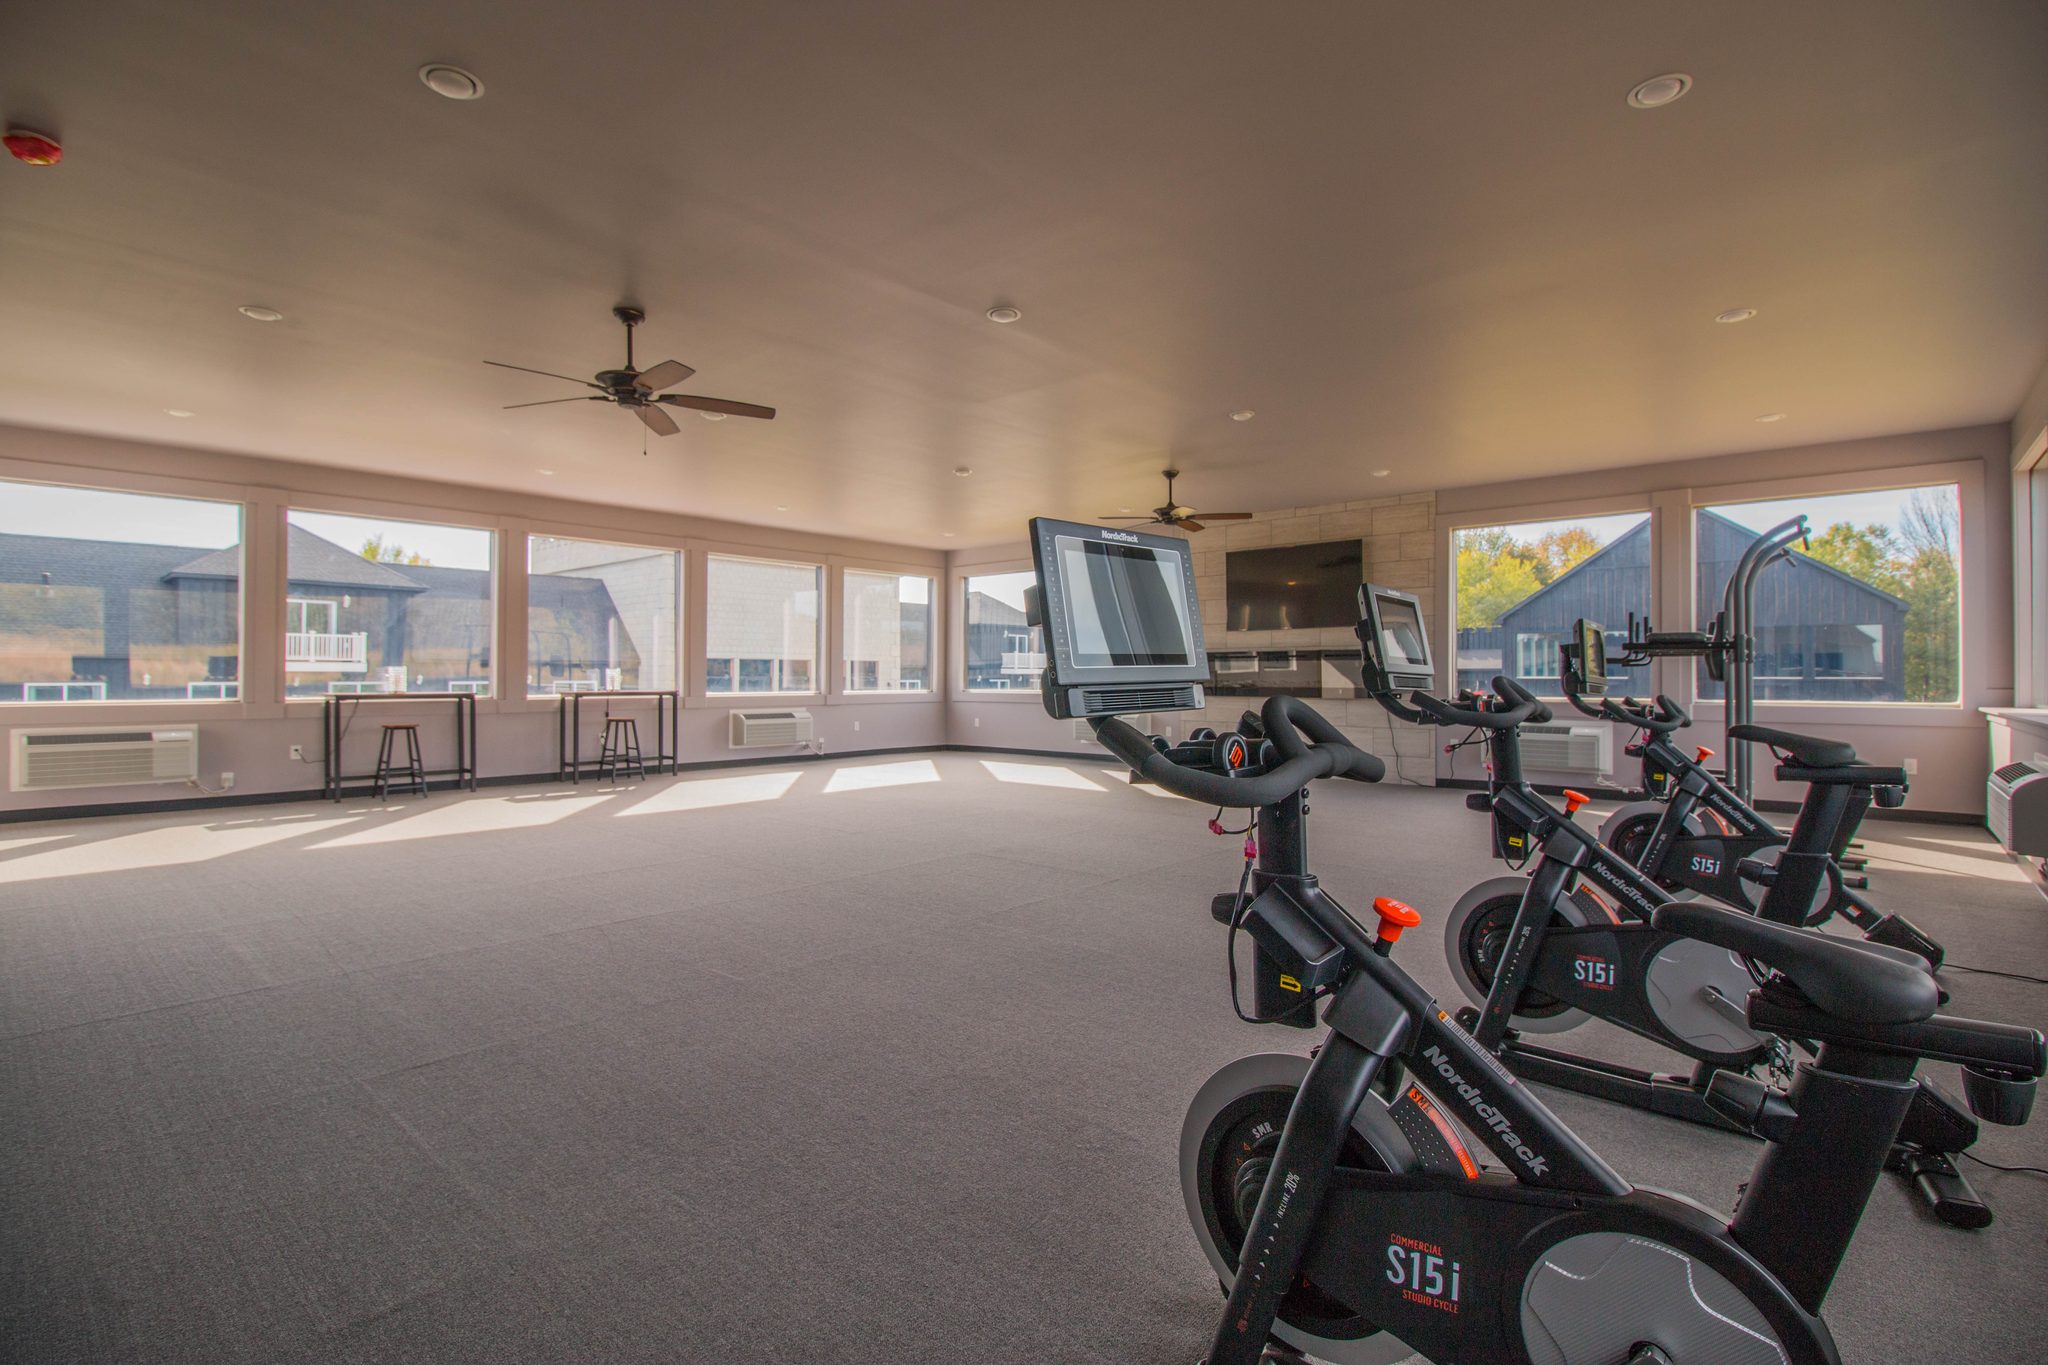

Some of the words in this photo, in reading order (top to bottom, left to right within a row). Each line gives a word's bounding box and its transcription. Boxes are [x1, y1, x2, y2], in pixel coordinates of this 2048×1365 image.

[1101, 530, 1139, 543] NordicTrack
[1710, 793, 1757, 832] NordicTrack
[1691, 857, 1720, 875] S15i
[1592, 862, 1655, 913] NordicTrac
[1574, 959, 1614, 985] S15i
[1423, 1045, 1549, 1176] NordicTrack
[1252, 1122, 1273, 1139] SMR
[1284, 1171, 1300, 1194] 20%
[1390, 1232, 1442, 1257] COMMERCIAL
[1386, 1245, 1460, 1302] S15i
[1402, 1288, 1433, 1306] STUDIO
[1433, 1298, 1459, 1314] CYCLE
